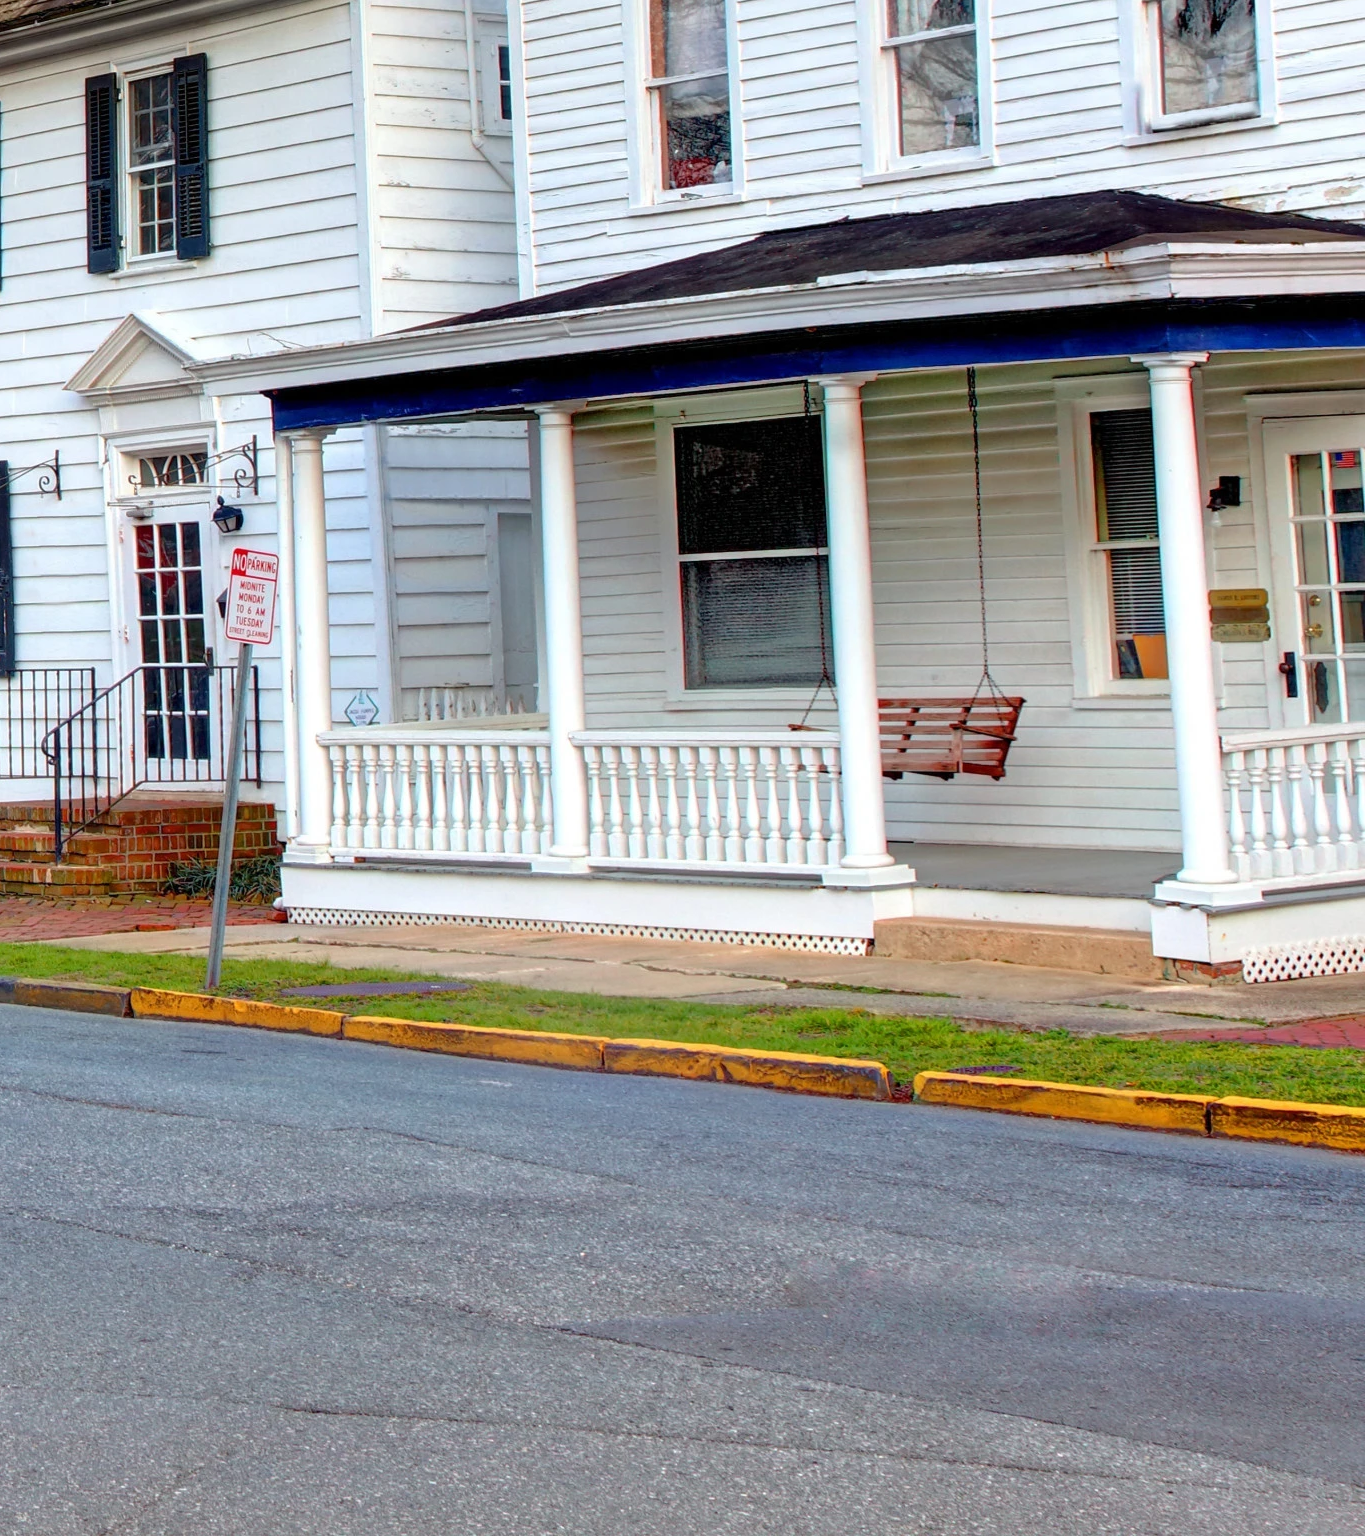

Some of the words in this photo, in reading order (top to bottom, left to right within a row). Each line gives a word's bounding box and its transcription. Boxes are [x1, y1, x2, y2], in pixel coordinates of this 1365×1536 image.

[233, 553, 247, 572] NO
[247, 558, 276, 574] PARKING
[240, 580, 266, 593] MIDNITE
[238, 592, 265, 604] MONDAY
[236, 604, 245, 614] TO
[247, 606, 252, 615] 6
[255, 607, 266, 617] AM
[235, 615, 264, 629] TUESDAY
[229, 626, 245, 635] STREET
[246, 629, 269, 639] CLEANING
